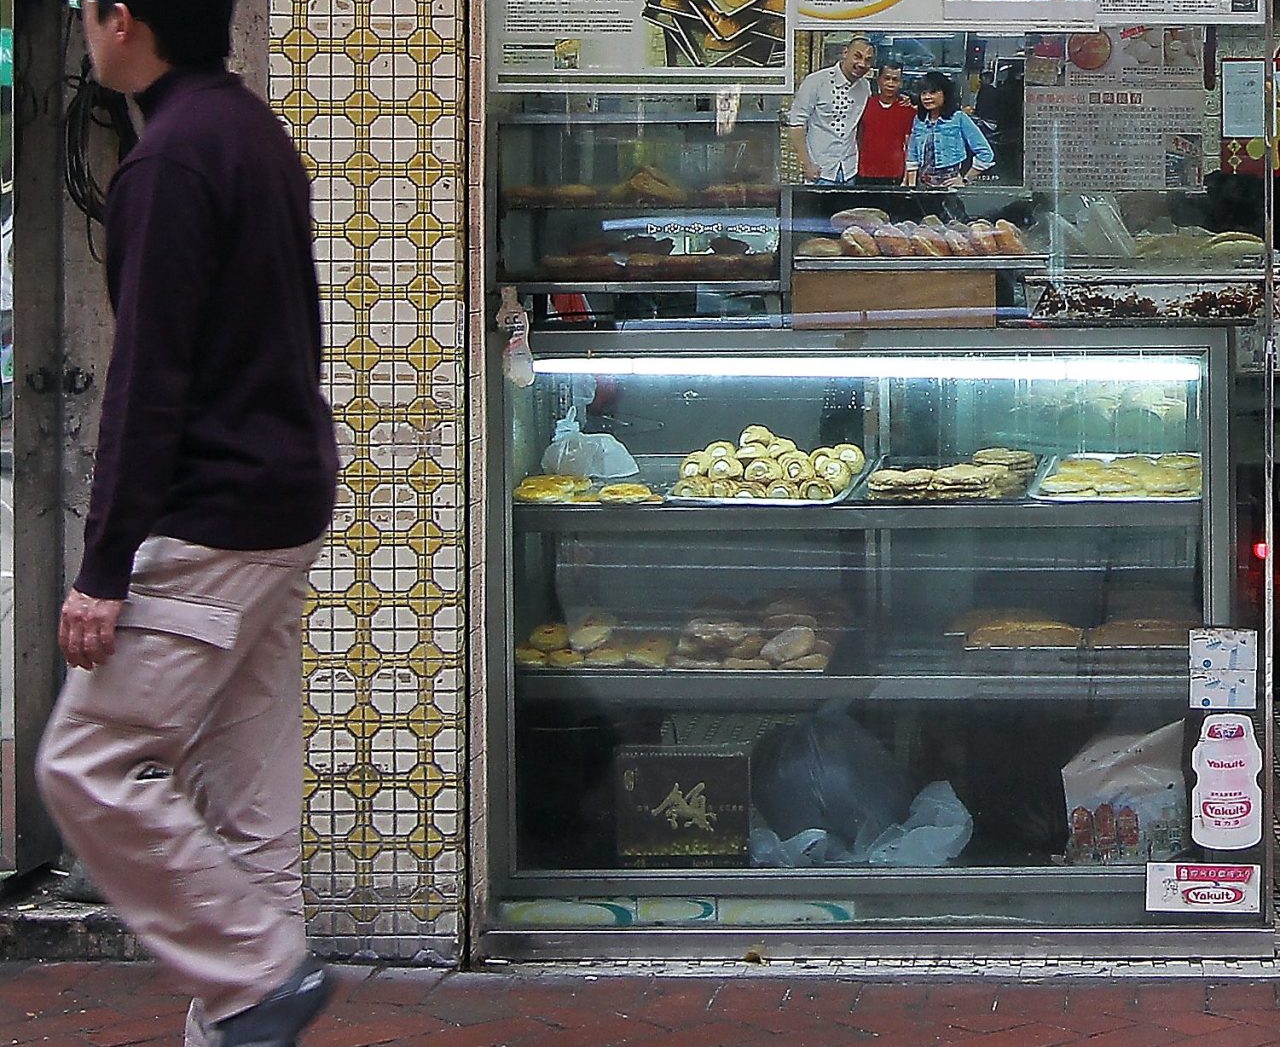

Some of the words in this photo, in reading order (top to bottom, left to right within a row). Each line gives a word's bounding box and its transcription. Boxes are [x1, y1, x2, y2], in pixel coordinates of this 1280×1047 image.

[1207, 759, 1246, 769] Yakult
[1208, 805, 1246, 816] Yakult
[1192, 891, 1233, 900] Yakult
